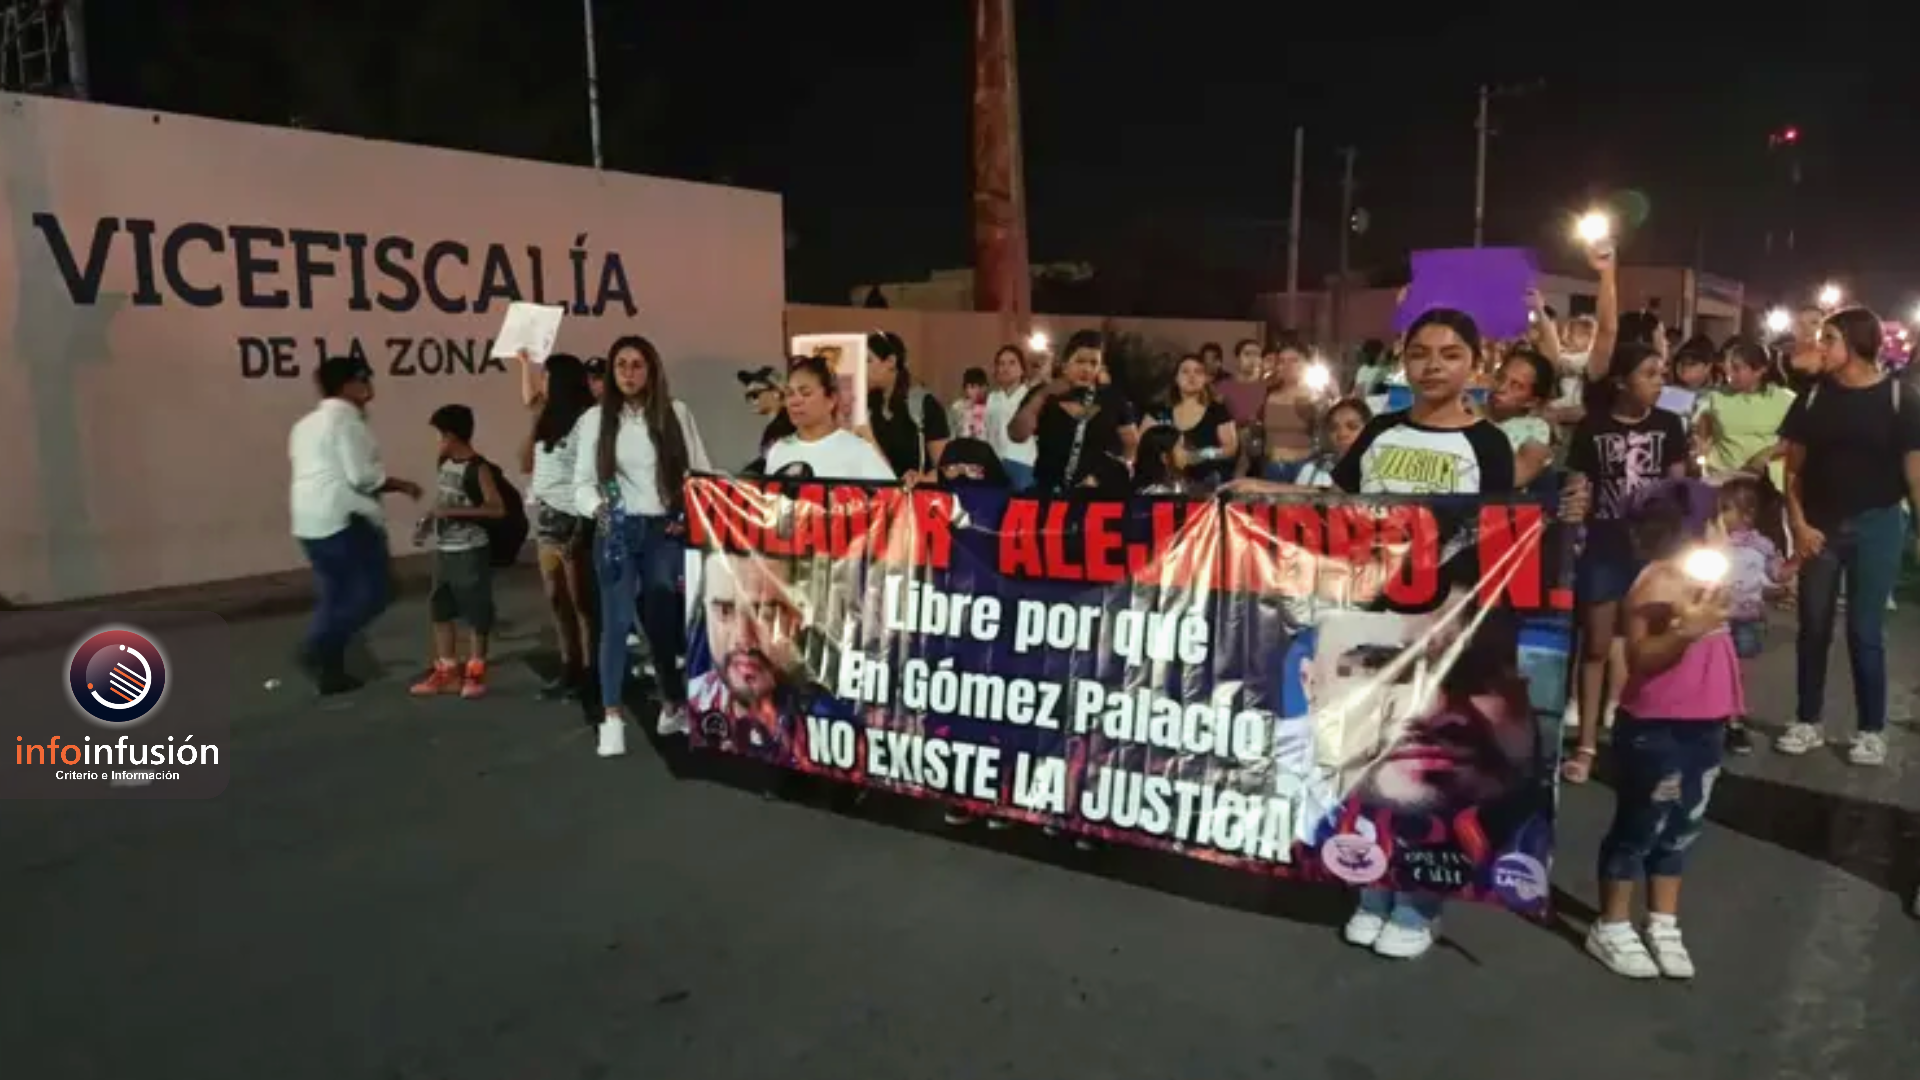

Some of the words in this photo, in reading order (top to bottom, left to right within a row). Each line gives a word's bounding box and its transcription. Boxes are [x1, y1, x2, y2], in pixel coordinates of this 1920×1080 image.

[33, 211, 638, 317] VICEFISCALÍA
[237, 336, 300, 378] DE
[385, 338, 507, 376] ZONA
[1479, 504, 1573, 609] N.
[884, 574, 1000, 642] Libre
[1014, 599, 1101, 653] por
[1113, 601, 1210, 667] qué
[838, 648, 890, 702] En
[902, 656, 1063, 730] Gómez
[806, 716, 855, 769] NO
[865, 732, 1000, 801] EXISTE
[1013, 752, 1067, 815] LA
[1080, 768, 1293, 865] JUSTICIA
